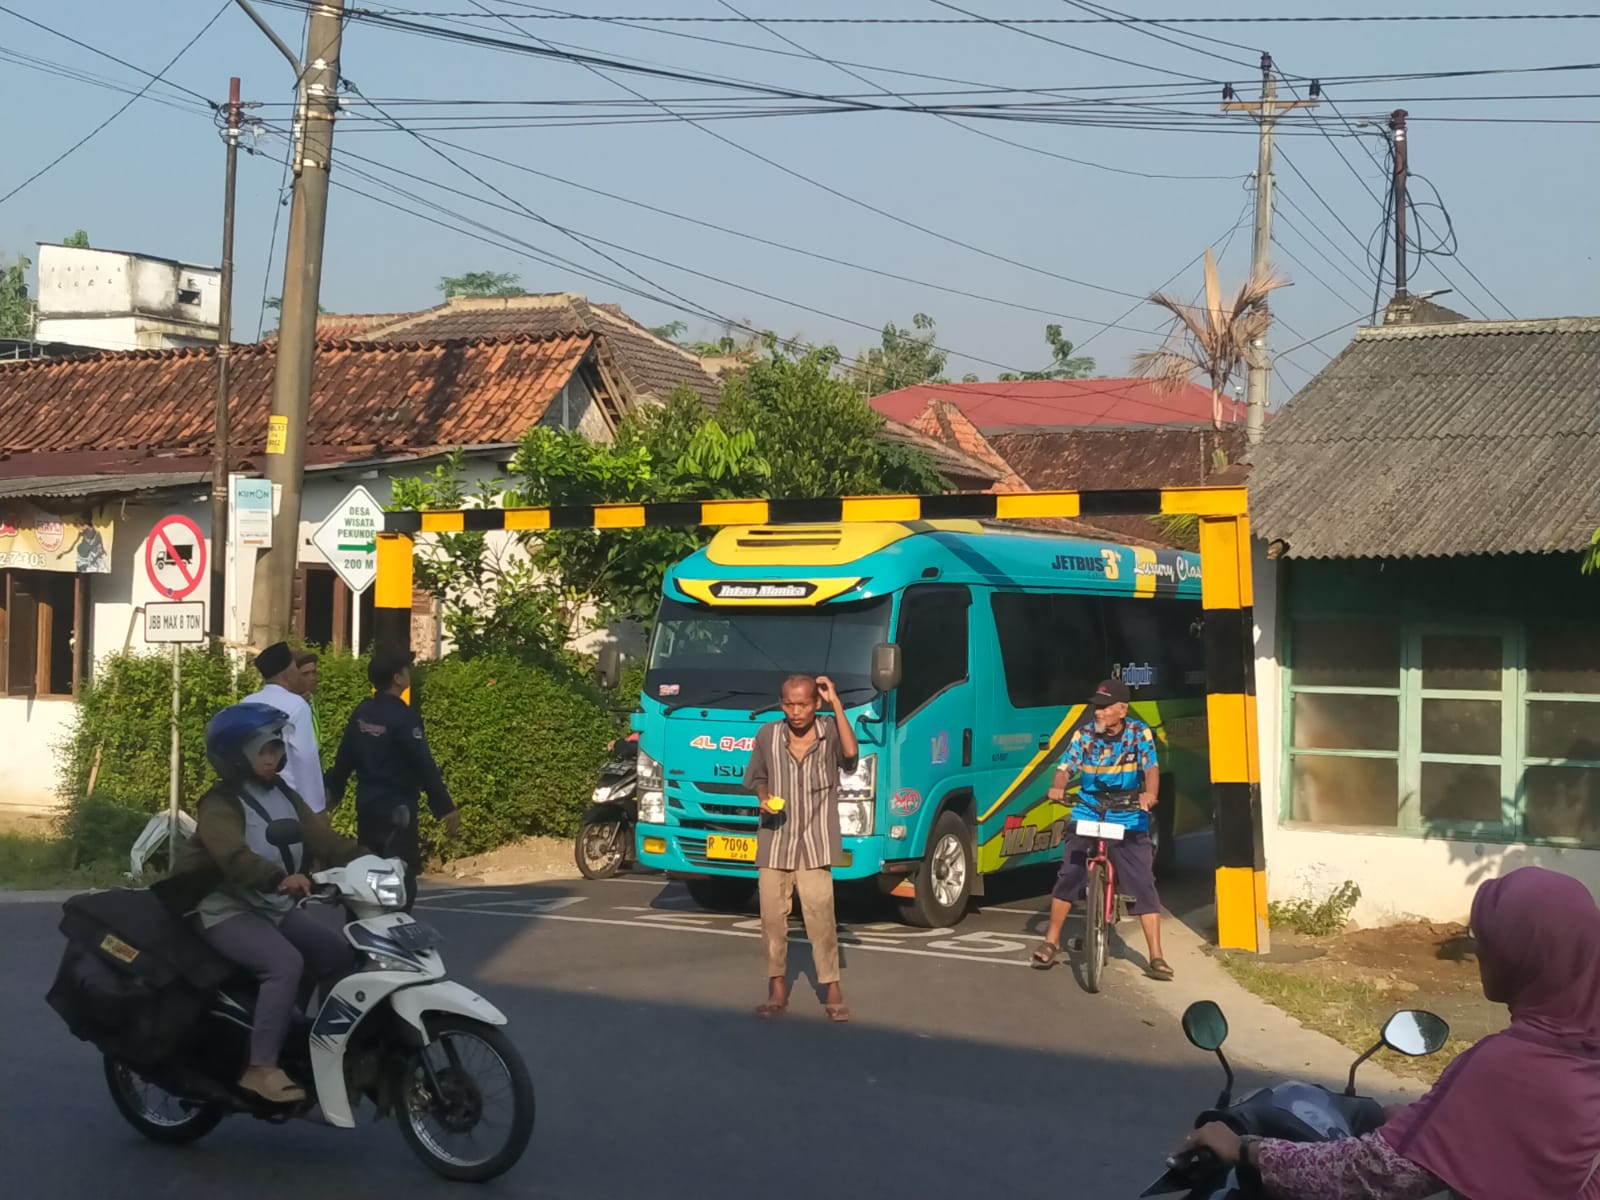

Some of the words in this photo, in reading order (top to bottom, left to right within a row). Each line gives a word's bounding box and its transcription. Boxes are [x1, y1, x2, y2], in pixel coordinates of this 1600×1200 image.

[238, 489, 269, 499] KUMON
[349, 506, 370, 516] DESA
[344, 518, 375, 527] WISATA
[337, 529, 376, 538] PEKUNDE
[344, 559, 362, 569] 200
[365, 559, 374, 569] M
[1134, 553, 1175, 582] Luxury
[1176, 555, 1202, 580] Clas
[163, 615, 178, 629] MAX
[186, 614, 201, 629] TON
[714, 765, 744, 777] ISU
[708, 836, 715, 849] R
[721, 837, 749, 851] 7096
